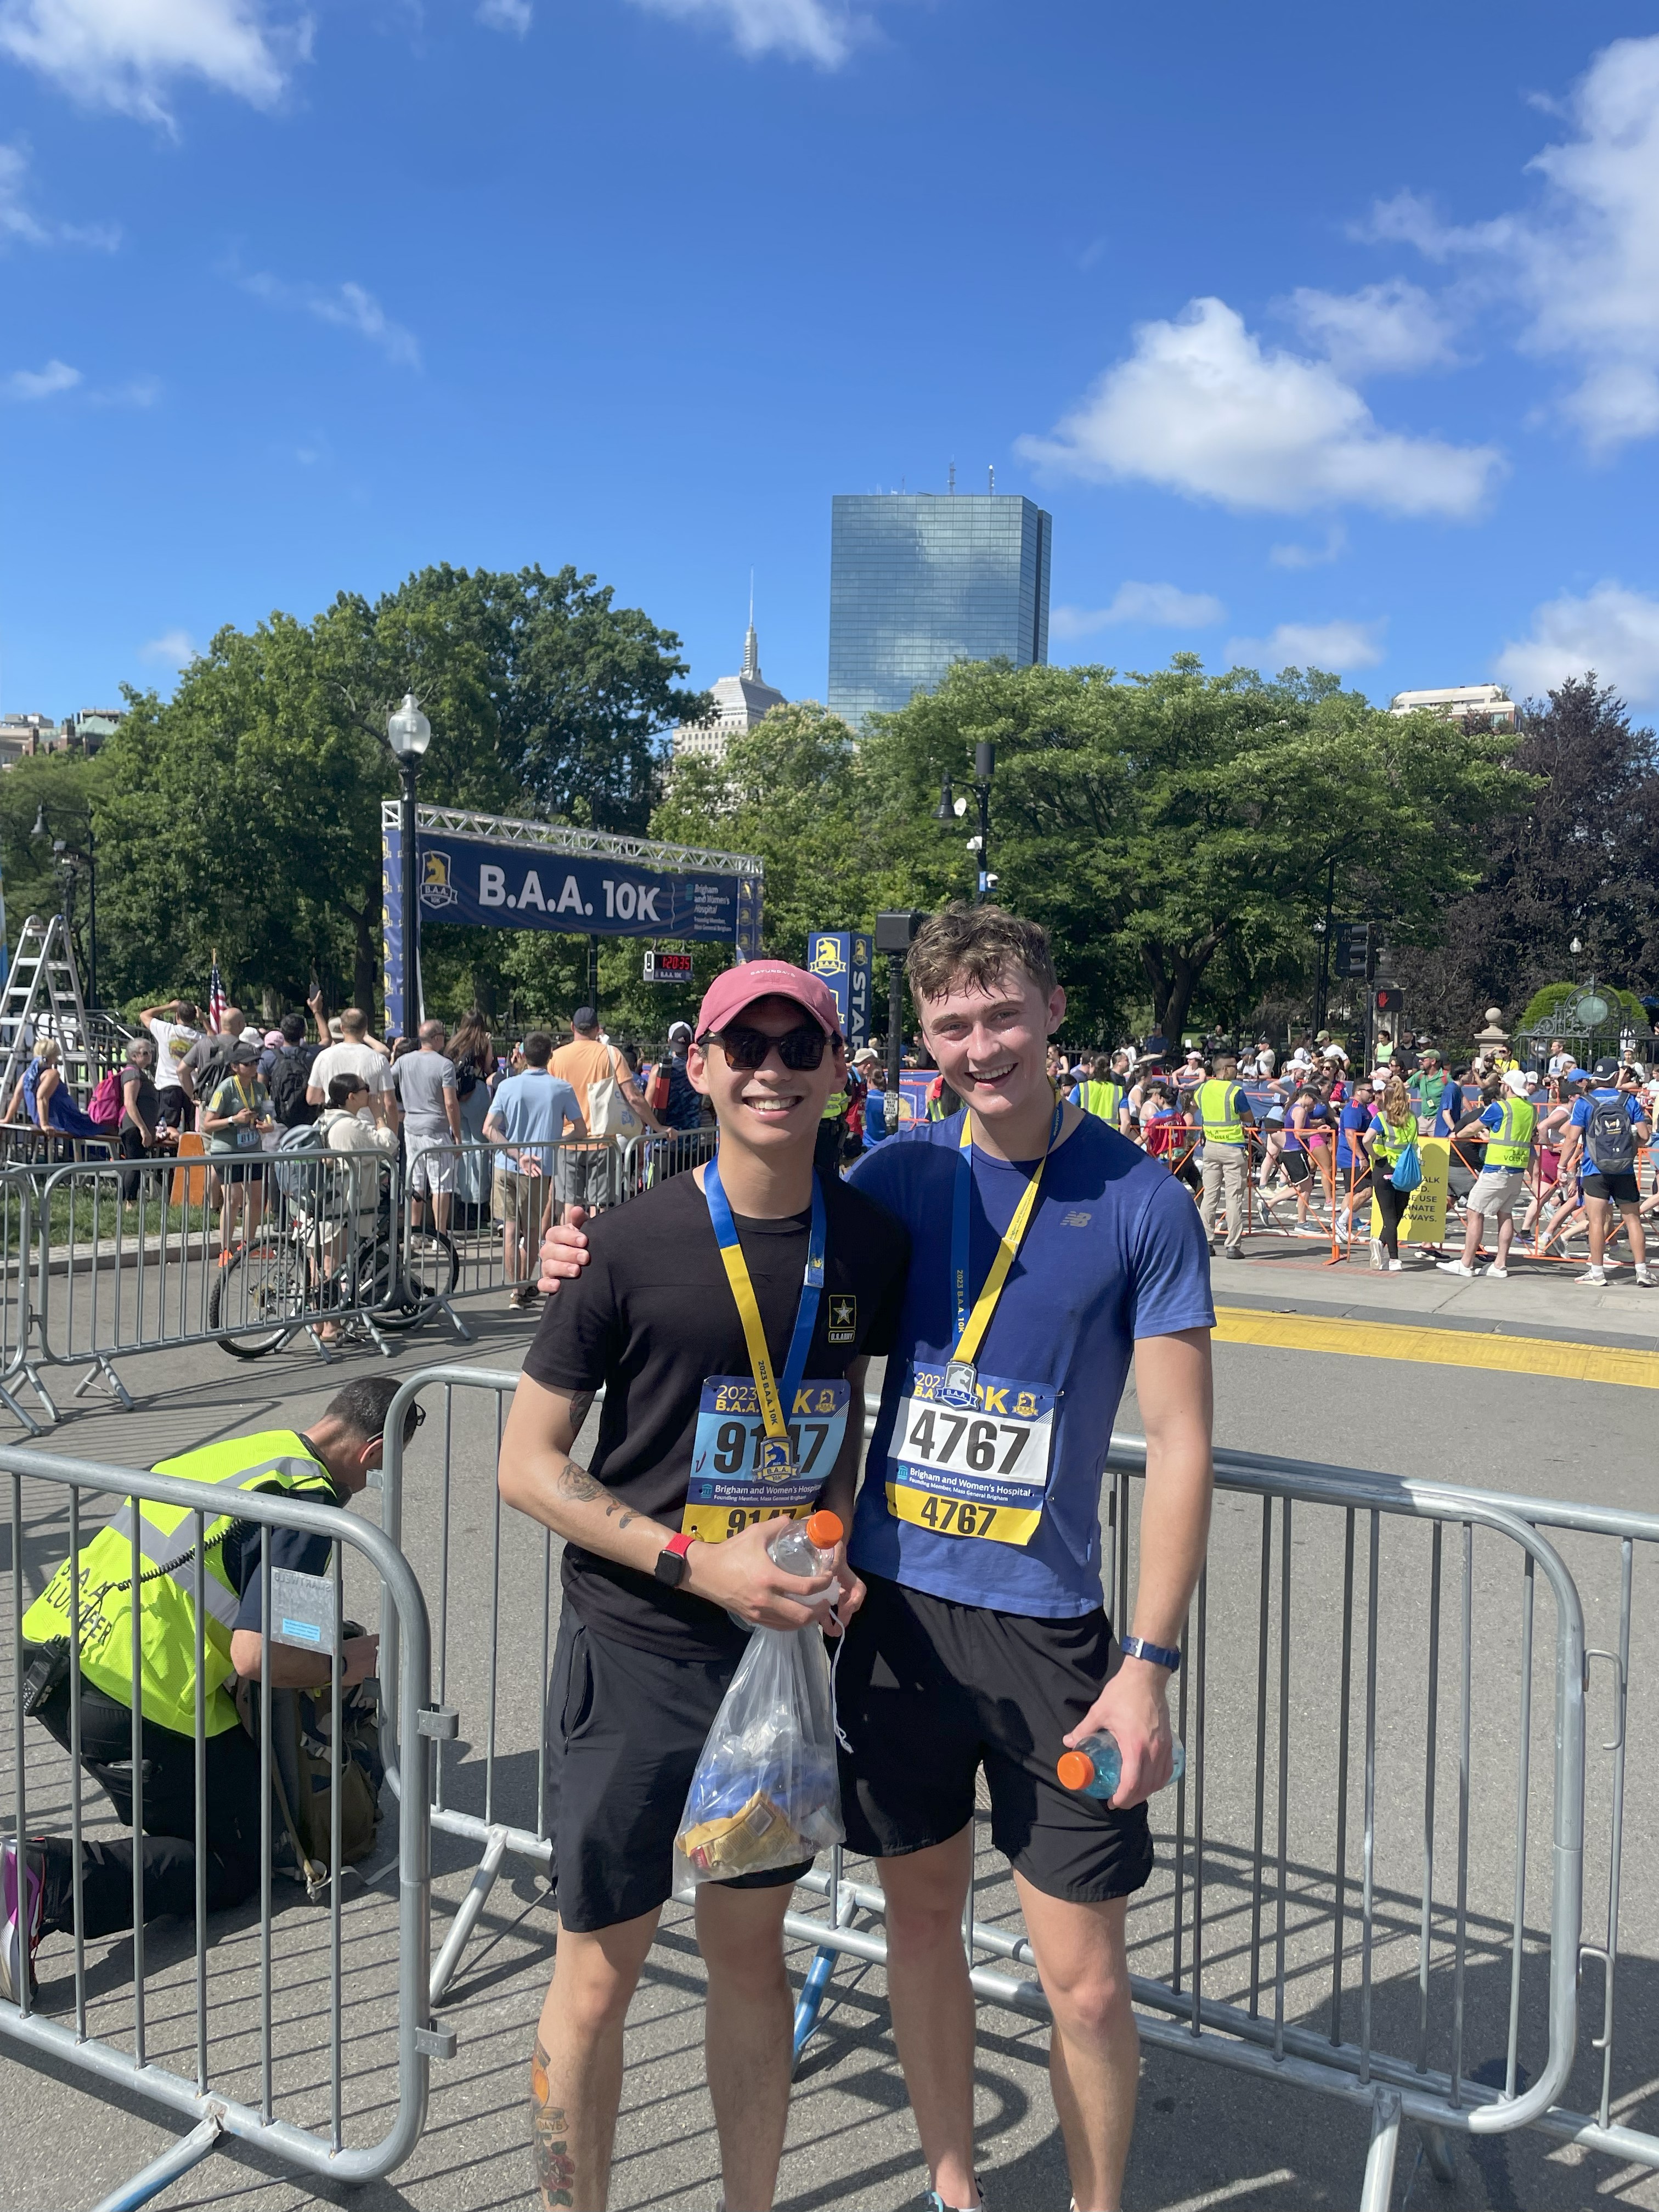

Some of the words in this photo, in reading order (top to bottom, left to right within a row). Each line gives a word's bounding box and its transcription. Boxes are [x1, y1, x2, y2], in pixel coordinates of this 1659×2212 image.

[425, 885, 448, 895] B.A.A.
[479, 864, 594, 916] B.A.A.
[602, 880, 661, 922] 10K
[851, 970, 866, 1051] STAR
[1402, 1214, 1437, 1222] KWAYS.
[916, 1372, 944, 1388] 202
[717, 1385, 758, 1401] 2023
[946, 1389, 967, 1400] B.A.A.
[715, 1400, 760, 1413] B.A.A.
[909, 1409, 1030, 1475] 4767
[910, 1467, 940, 1483] Brigham
[941, 1476, 957, 1486] and
[958, 1479, 995, 1493] Women's
[715, 1485, 748, 1495] Brigham
[750, 1486, 764, 1494] and
[766, 1486, 797, 1494] Women's
[798, 1483, 822, 1494] Hospital
[909, 1476, 930, 1488] Founding
[930, 1482, 952, 1493] Member,
[966, 1490, 986, 1498] General
[986, 1493, 1008, 1502] Brigham
[921, 1496, 997, 1536] 4767
